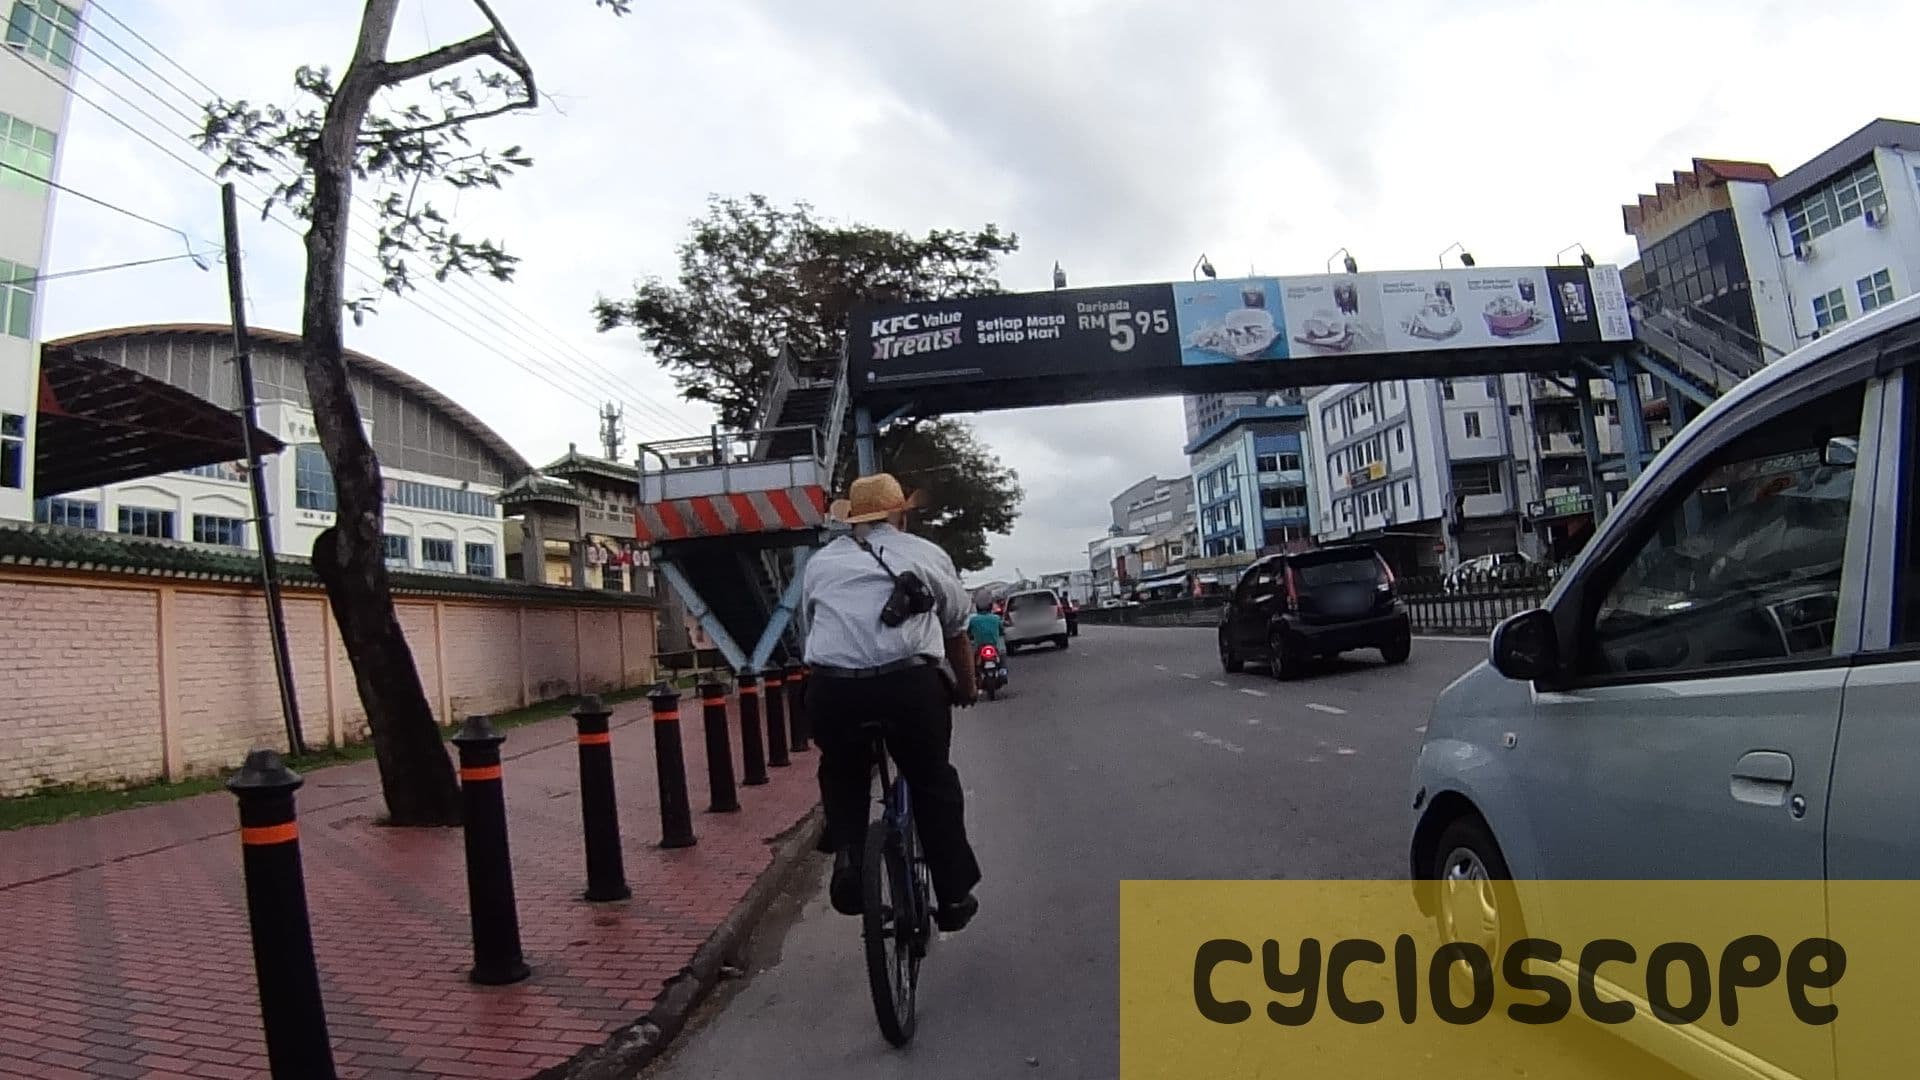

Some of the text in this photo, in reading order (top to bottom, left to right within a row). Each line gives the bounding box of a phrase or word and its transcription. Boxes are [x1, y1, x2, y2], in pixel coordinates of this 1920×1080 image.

[1077, 300, 1130, 313] Daripada
[870, 311, 962, 337] KFC Value
[977, 314, 1065, 332] Setiap Masa
[1078, 315, 1105, 330] RM
[879, 328, 954, 360] Treats
[977, 326, 1060, 345] Setiap Hari
